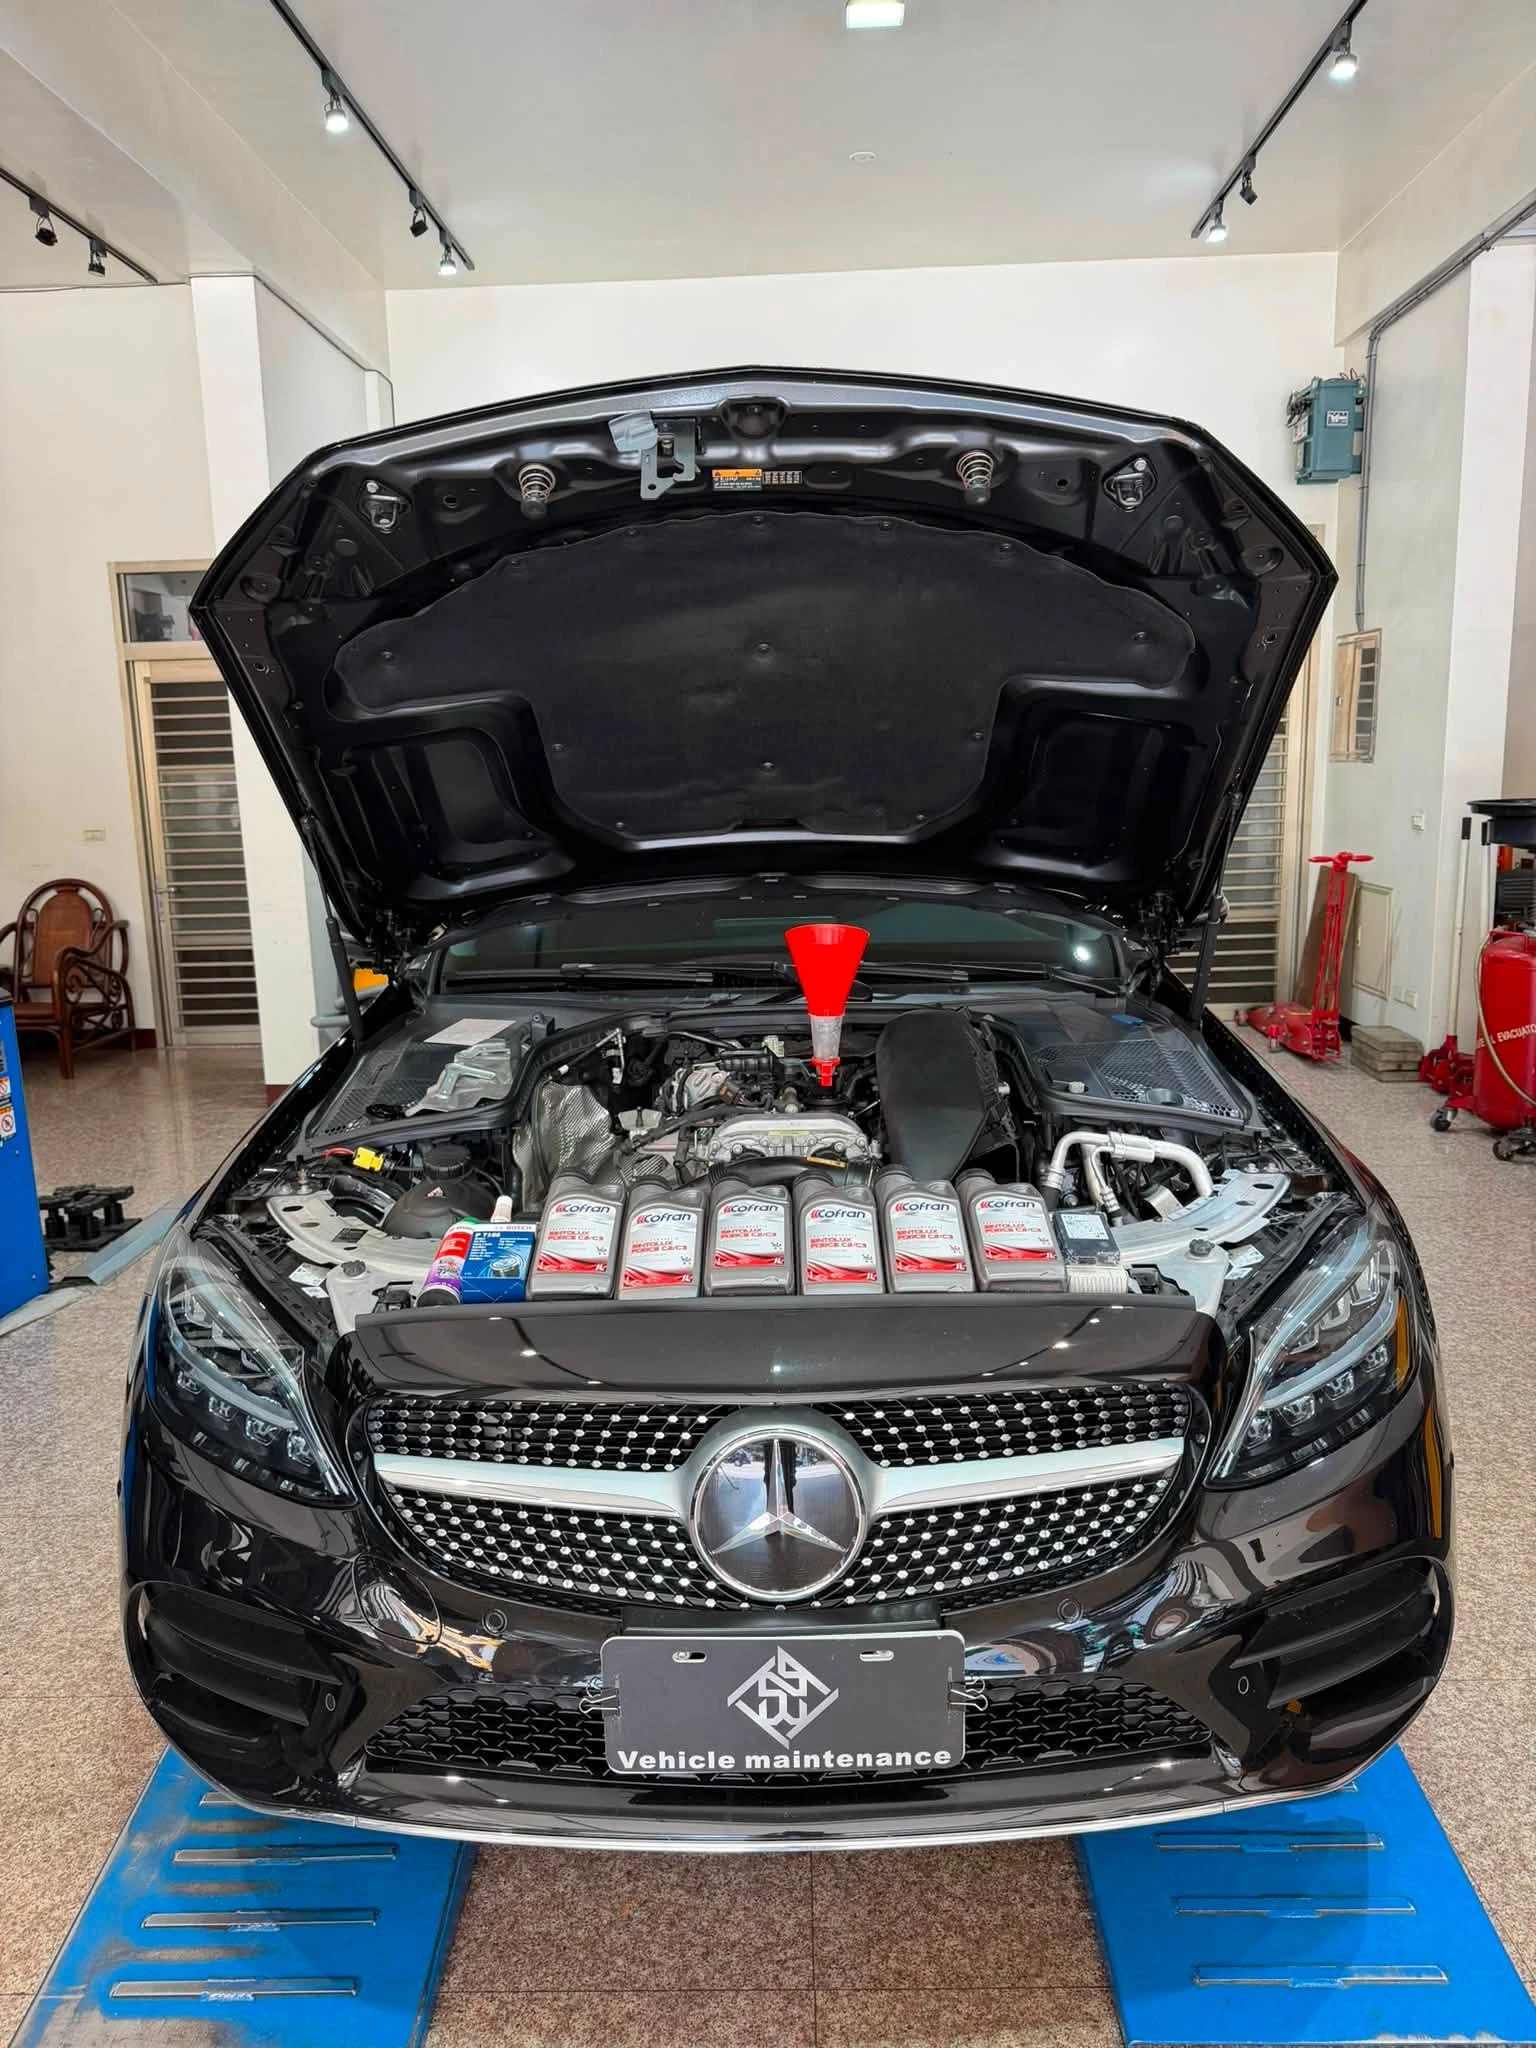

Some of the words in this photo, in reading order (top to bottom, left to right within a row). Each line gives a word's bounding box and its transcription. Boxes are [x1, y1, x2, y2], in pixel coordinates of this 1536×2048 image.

[562, 1203, 610, 1213] Cofran
[730, 1203, 778, 1213] Cofran
[902, 1201, 949, 1212] Cofran
[987, 1199, 1035, 1208] Cofran
[644, 1212, 691, 1224] Cofran
[818, 1208, 866, 1218] Cofran
[617, 1750, 736, 1770] Vehicle
[745, 1748, 952, 1769] maintenance
